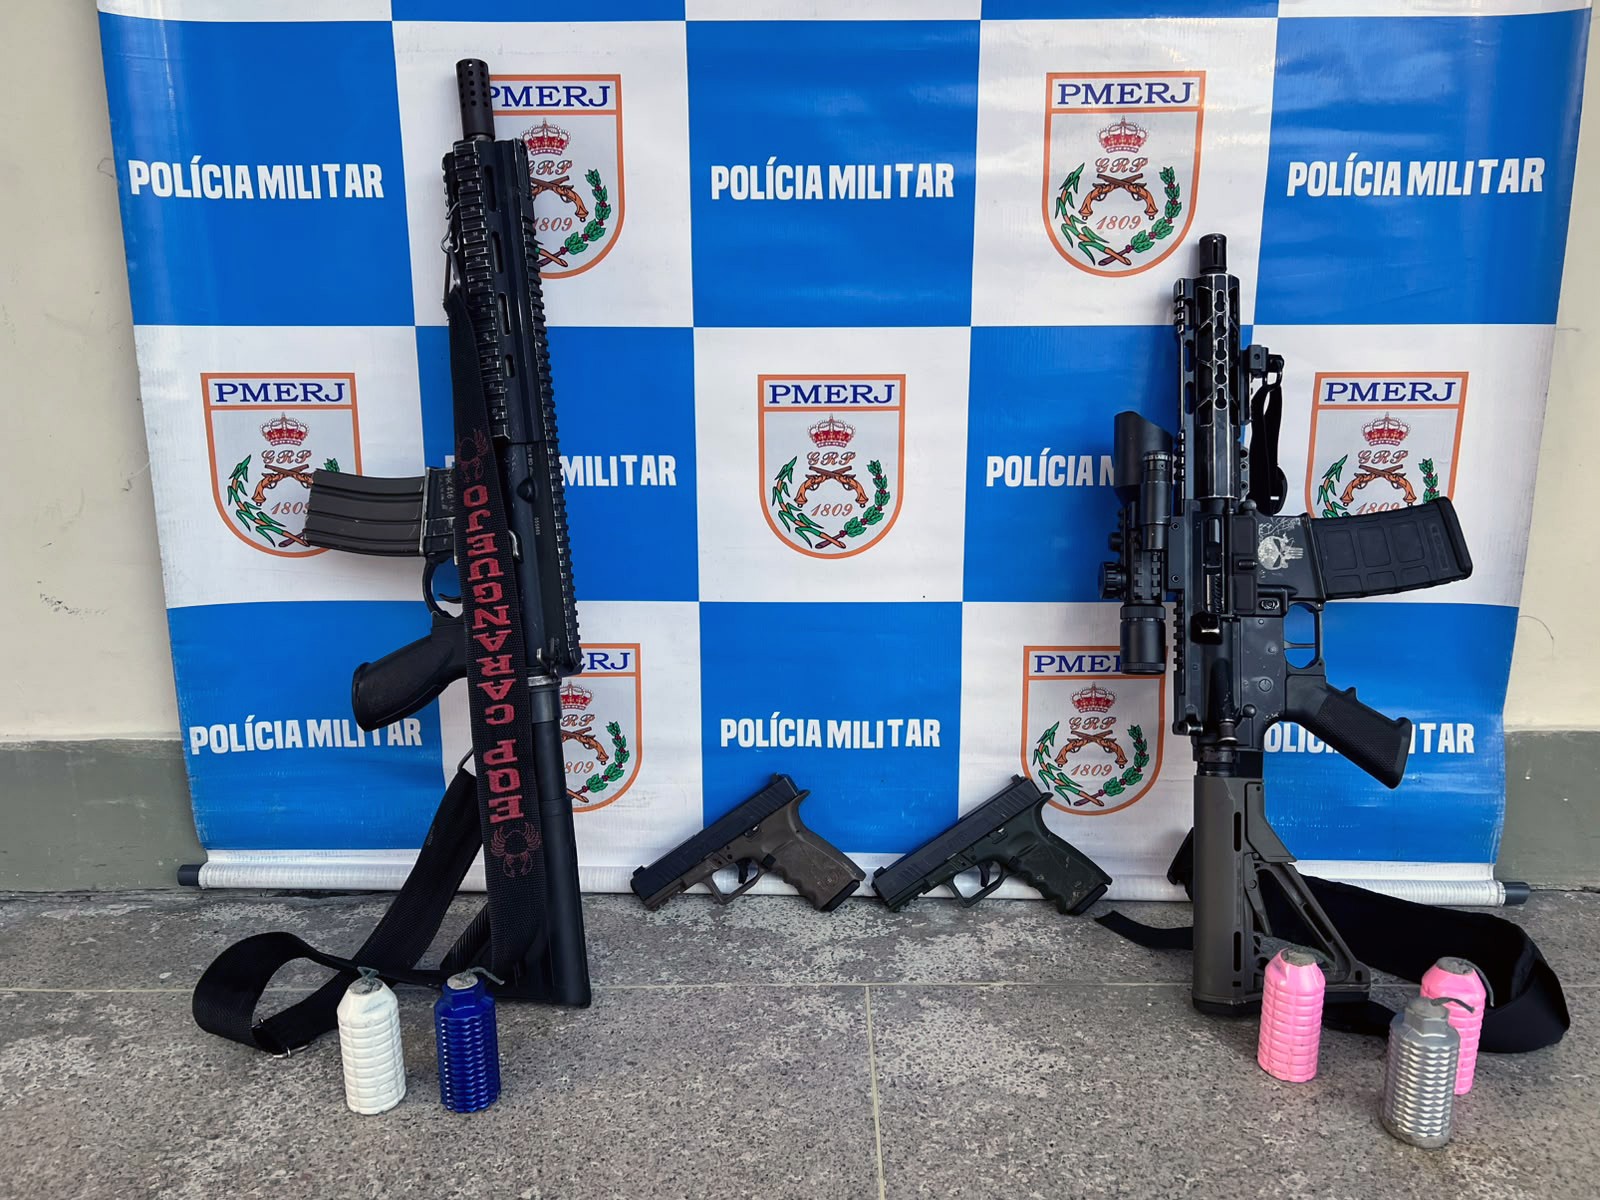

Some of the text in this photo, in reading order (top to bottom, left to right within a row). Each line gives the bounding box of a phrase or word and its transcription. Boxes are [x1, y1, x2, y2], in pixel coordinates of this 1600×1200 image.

[1057, 82, 1195, 105] PMERJ
[128, 155, 384, 200] POLÍCIA MILITAR
[711, 156, 954, 200] POLÍCIA MILITAR
[1286, 152, 1546, 197] POLÍCIA MILITAR
[1096, 215, 1141, 230] 1809
[214, 382, 346, 403] PMERJ
[768, 384, 895, 404] PMERJ
[1324, 381, 1456, 402] PMERJ
[559, 454, 677, 487] MILITAR
[986, 447, 1094, 487] POLÍCIA
[810, 503, 853, 517] 1809
[463, 485, 524, 824] EQP CARANGUEJO
[561, 714, 595, 727] RP
[720, 711, 941, 749] POLÍCIA MILITAR
[189, 714, 303, 755] POLÍCIA
[564, 760, 595, 774] 809
[1070, 763, 1113, 776] 1809
